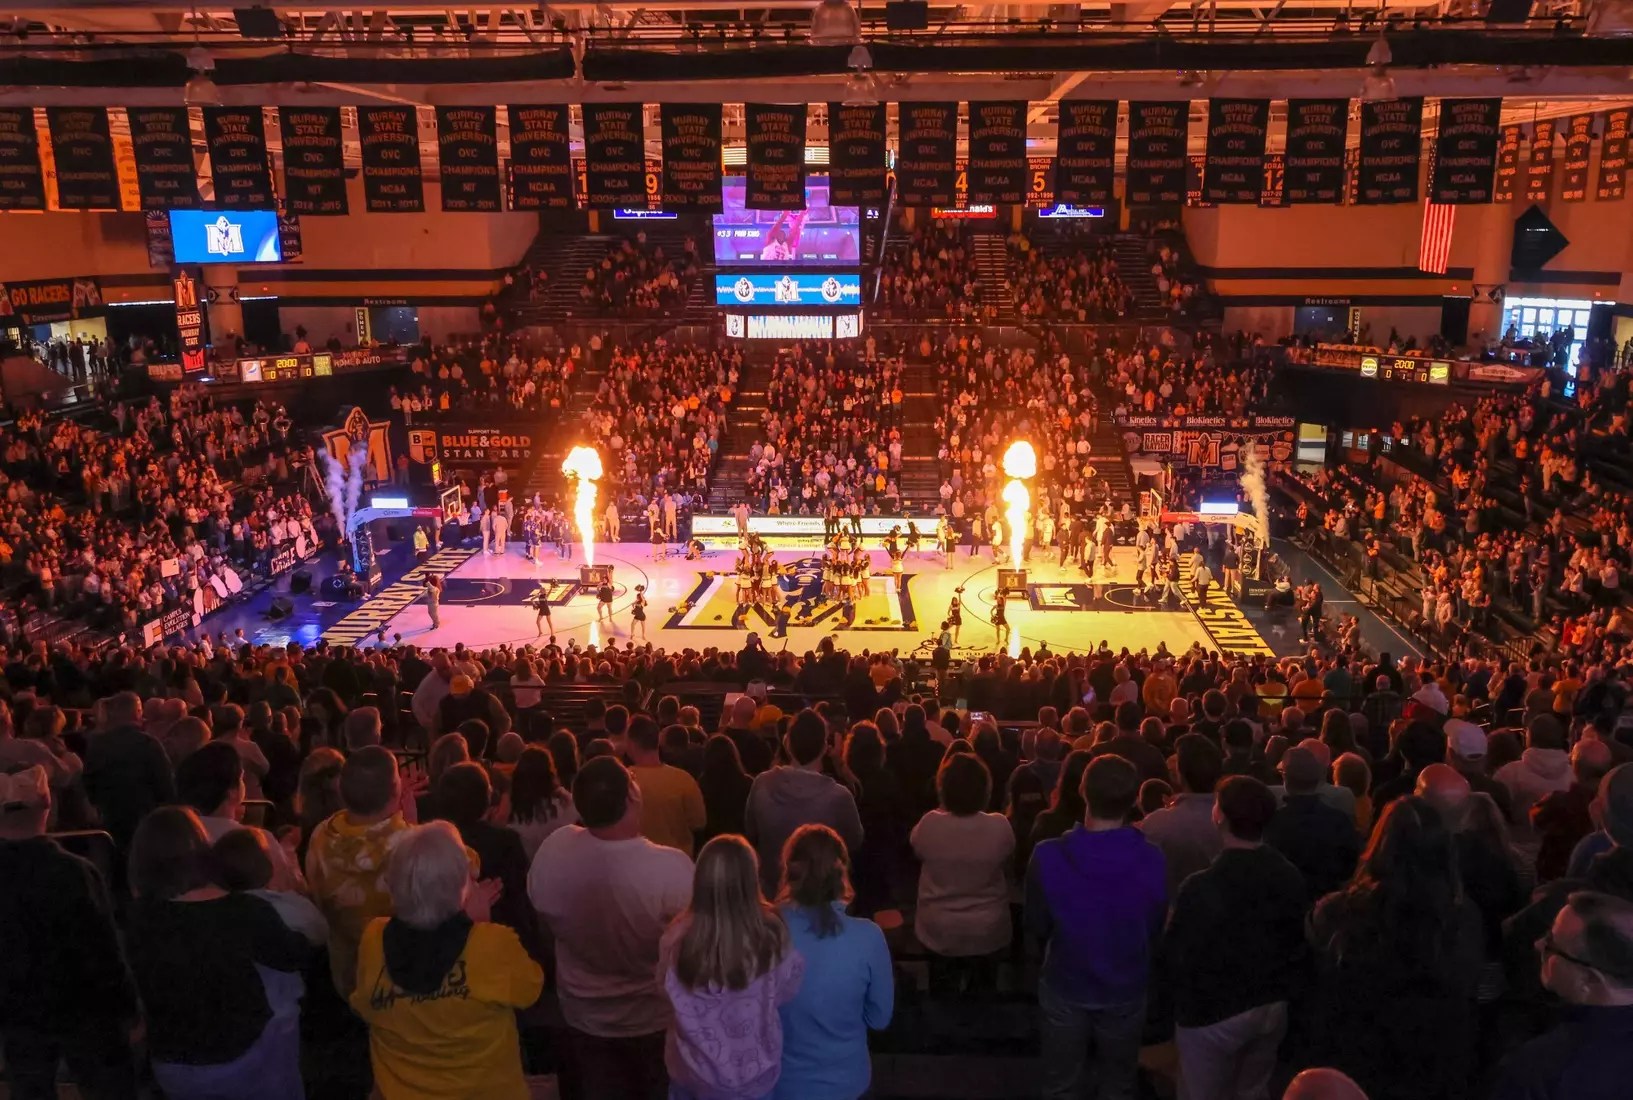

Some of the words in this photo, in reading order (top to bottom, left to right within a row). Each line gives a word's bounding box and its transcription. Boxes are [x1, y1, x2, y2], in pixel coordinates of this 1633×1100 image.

[911, 108, 948, 118] MURRAY
[980, 107, 1018, 116] MURRAY
[1070, 106, 1108, 115] MURRAY
[1141, 106, 1179, 117] MURRAY
[1220, 104, 1259, 114] MURRAY
[1300, 104, 1339, 113] MURRAY
[289, 114, 328, 124] MURRAY
[368, 112, 407, 121] MURRAY
[446, 111, 486, 121] MURRAY
[519, 110, 558, 121] MURRAY
[595, 111, 632, 121] MURRAY
[672, 115, 709, 126] MURRAY
[756, 112, 793, 122] MURRAY
[1074, 115, 1103, 124] STATE
[1225, 114, 1252, 122] STATE
[1304, 115, 1330, 124] STATE
[452, 121, 481, 130] STATE
[524, 121, 554, 130] STATE
[600, 121, 628, 131] STATE
[916, 119, 942, 128] STATE
[985, 116, 1013, 126] STATE
[1145, 118, 1174, 126] STATE
[296, 126, 325, 134] STATE
[374, 122, 403, 132] STATE
[678, 126, 706, 136] STATE
[760, 122, 790, 132] STATE
[1062, 126, 1112, 137] UNIVERSITY
[1212, 124, 1263, 136] UNIVERSITY
[1290, 124, 1343, 137] UNIVERSITY
[440, 130, 493, 145] UNIVERSITY
[512, 130, 566, 144] UNIVERSITY
[589, 130, 639, 144] UNIVERSITY
[750, 132, 800, 144] UNIVERSITY
[904, 128, 952, 142] UNIVERSITY
[973, 127, 1024, 139] UNIVERSITY
[1132, 128, 1184, 140] UNIVERSITY
[285, 136, 338, 147] UNIVERSITY
[363, 132, 416, 145] UNIVERSITY
[666, 136, 716, 147] UNIVERSITY
[989, 142, 1008, 152] OVC
[1076, 142, 1096, 150] OVC
[1148, 143, 1168, 152] OVC
[1227, 140, 1246, 149] OVC
[1306, 140, 1325, 149] OVC
[1381, 139, 1400, 149] OVC
[380, 150, 400, 160] OVC
[458, 148, 478, 158] OVC
[530, 148, 552, 158] OVC
[606, 146, 624, 156] OVC
[682, 148, 701, 158] OVC
[765, 148, 784, 158] OVC
[848, 146, 868, 155] OVC
[918, 146, 937, 154] OVC
[304, 153, 324, 162] OVC
[1208, 156, 1262, 166] CHAMPIONS
[1288, 156, 1340, 167] CHAMPIONS
[590, 162, 641, 172] CHAMPIONS
[668, 161, 717, 171] TOURNAMENT
[902, 160, 952, 171] CHAMPIONS
[972, 158, 1024, 168] CHAMPIONS
[1060, 158, 1111, 168] CHAMPIONS
[1131, 160, 1184, 168] CHAMPIONS
[288, 168, 340, 178] CHAMPIONS
[365, 166, 419, 176] CHAMPIONS
[442, 166, 496, 176] CHAMPIONS
[514, 164, 568, 175] CHAMPIONS
[751, 164, 800, 174] TOURNAMENT
[670, 172, 714, 180] CHAMPIONS
[754, 174, 798, 182] CHAMPIONS
[984, 176, 1010, 185] NCAA
[1072, 175, 1096, 184] NCAA
[1151, 175, 1164, 184] NIT
[1220, 174, 1245, 182] NCAA
[1306, 172, 1321, 182] NIT
[1376, 172, 1401, 182] NCAA
[462, 182, 477, 192] NIT
[604, 179, 629, 188] NCAA
[646, 174, 658, 194] 9
[680, 182, 704, 191] NCAA
[763, 182, 788, 191] NCAA
[913, 178, 938, 188] NCAA
[1033, 172, 1046, 192] 5
[308, 184, 322, 194] NIT
[380, 184, 406, 194] NCAA
[528, 182, 556, 193] NCAA
[12, 288, 28, 306] GO
[28, 284, 70, 304] RACERS
[178, 313, 200, 326] RACERS
[181, 328, 200, 338] MURRAY
[186, 338, 198, 346] STATE
[277, 358, 298, 368] 20:00
[363, 356, 381, 364] AUTO
[1394, 360, 1414, 370] 20:00
[270, 371, 276, 379] 0
[306, 368, 312, 376] 0
[1386, 370, 1392, 378] 0
[1421, 373, 1426, 382] 0
[1186, 416, 1226, 424] BioKinetics
[1256, 416, 1294, 424] BioKinetics
[413, 434, 421, 444] B
[1144, 434, 1170, 442] RACER
[1144, 442, 1170, 450] NATION
[164, 608, 182, 622] CAMPUS
[164, 612, 190, 630] EVOLUTION
[165, 620, 188, 636] VILLAGES
